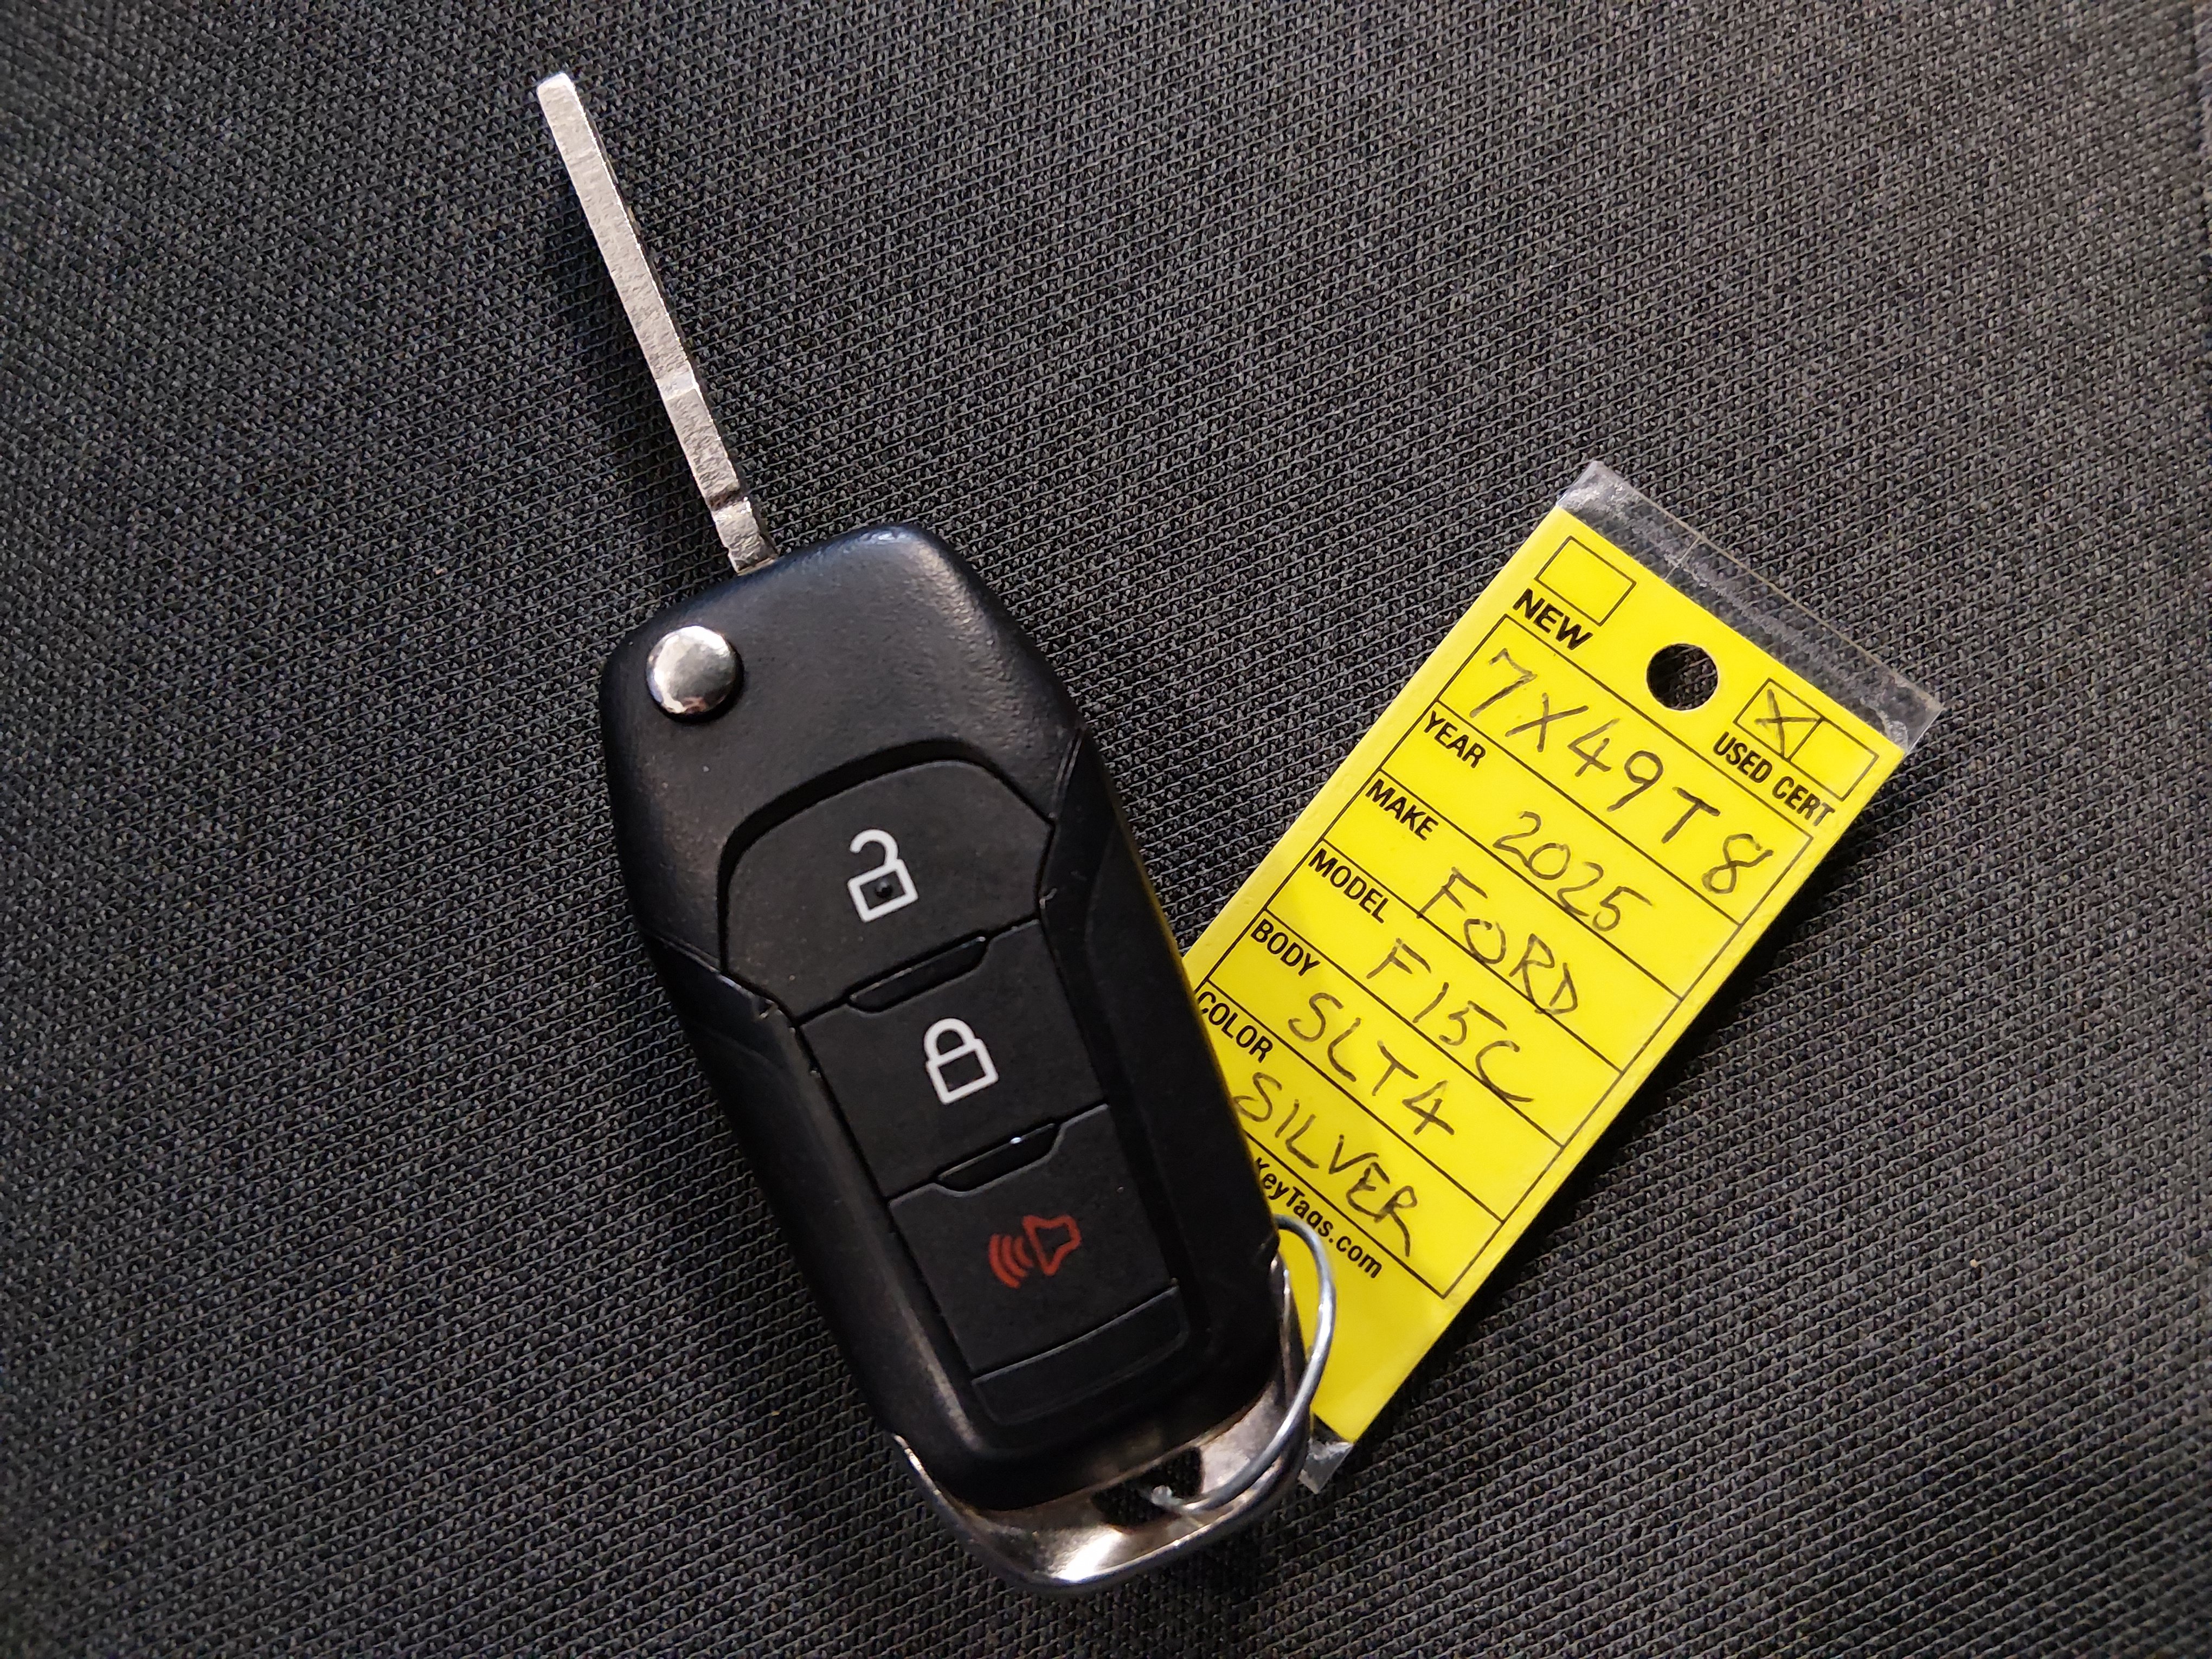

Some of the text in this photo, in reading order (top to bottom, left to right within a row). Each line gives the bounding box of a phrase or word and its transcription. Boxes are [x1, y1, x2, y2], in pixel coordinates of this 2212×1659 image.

[1513, 588, 1593, 651] NEW
[1423, 710, 1486, 769] YEAR
[1365, 778, 1439, 841] MAKE
[1713, 731, 1836, 827] USED CERT
[1308, 847, 1389, 924] MODEL
[1492, 811, 1652, 933] 2025
[1250, 918, 1321, 977] BODY
[1416, 866, 1579, 1015] FORD
[1198, 991, 1273, 1063] COLOR
[1288, 992, 1455, 1136] SLT4
[1233, 1072, 1417, 1257] SILVER
